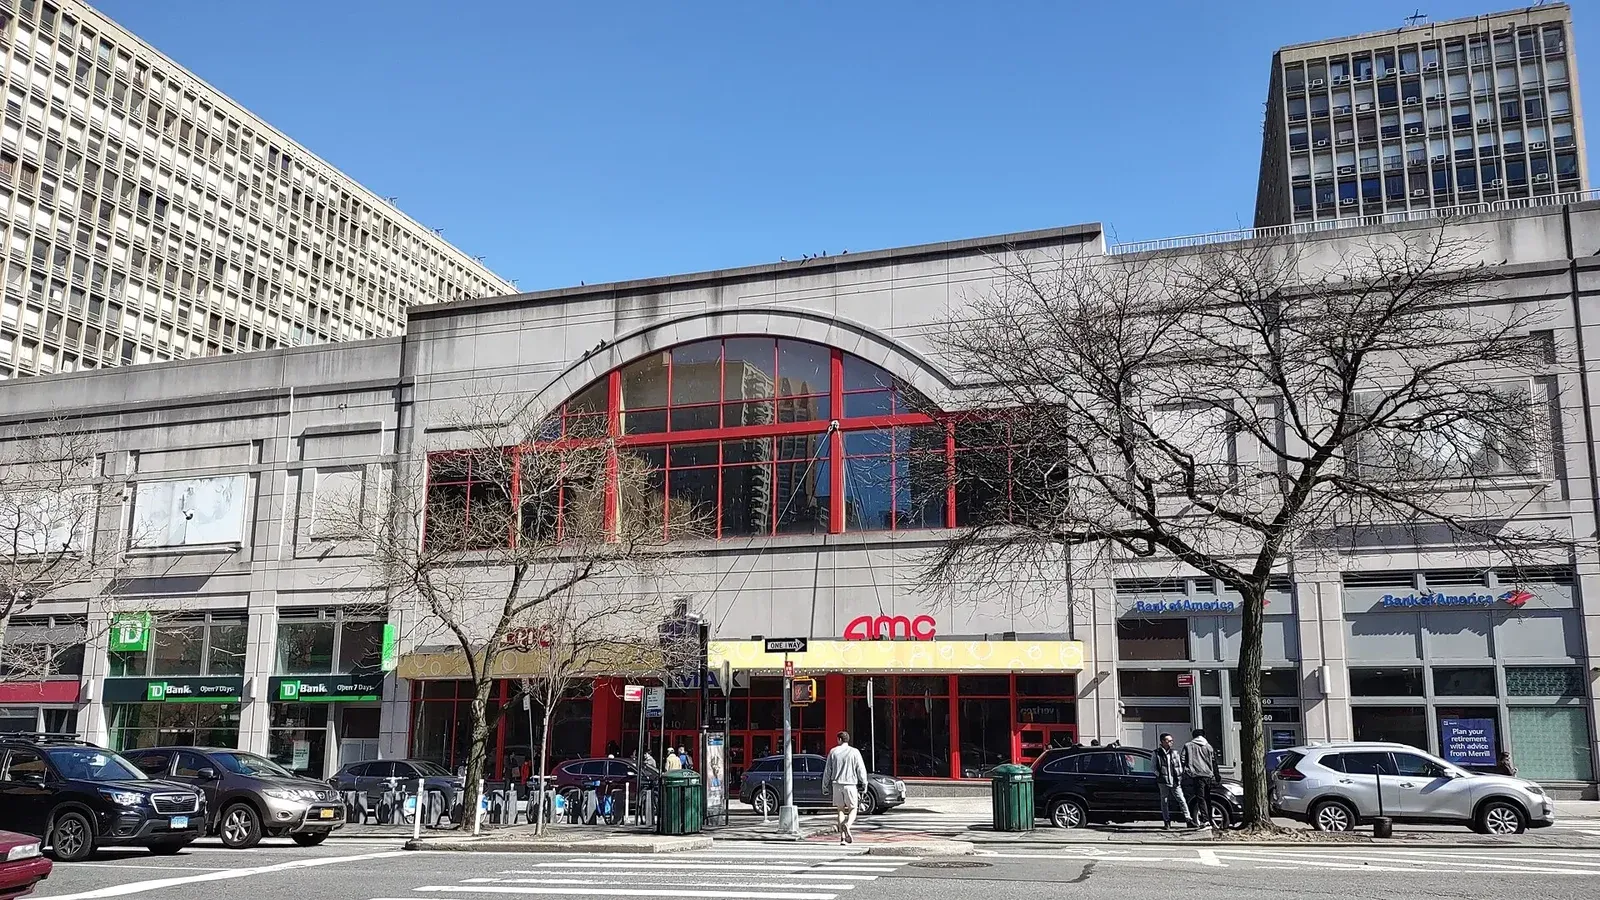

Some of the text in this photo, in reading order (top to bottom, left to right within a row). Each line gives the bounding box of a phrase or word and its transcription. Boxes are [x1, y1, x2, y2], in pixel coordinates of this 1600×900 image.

[1136, 599, 1234, 612] Bank of America
[1383, 593, 1494, 607] Bank of America
[119, 620, 142, 643] TD
[150, 685, 163, 697] TD
[166, 684, 191, 694] Bank
[282, 683, 296, 696] TD
[300, 683, 328, 693] Bank
[336, 684, 353, 692] Open
[358, 684, 373, 692] Days
